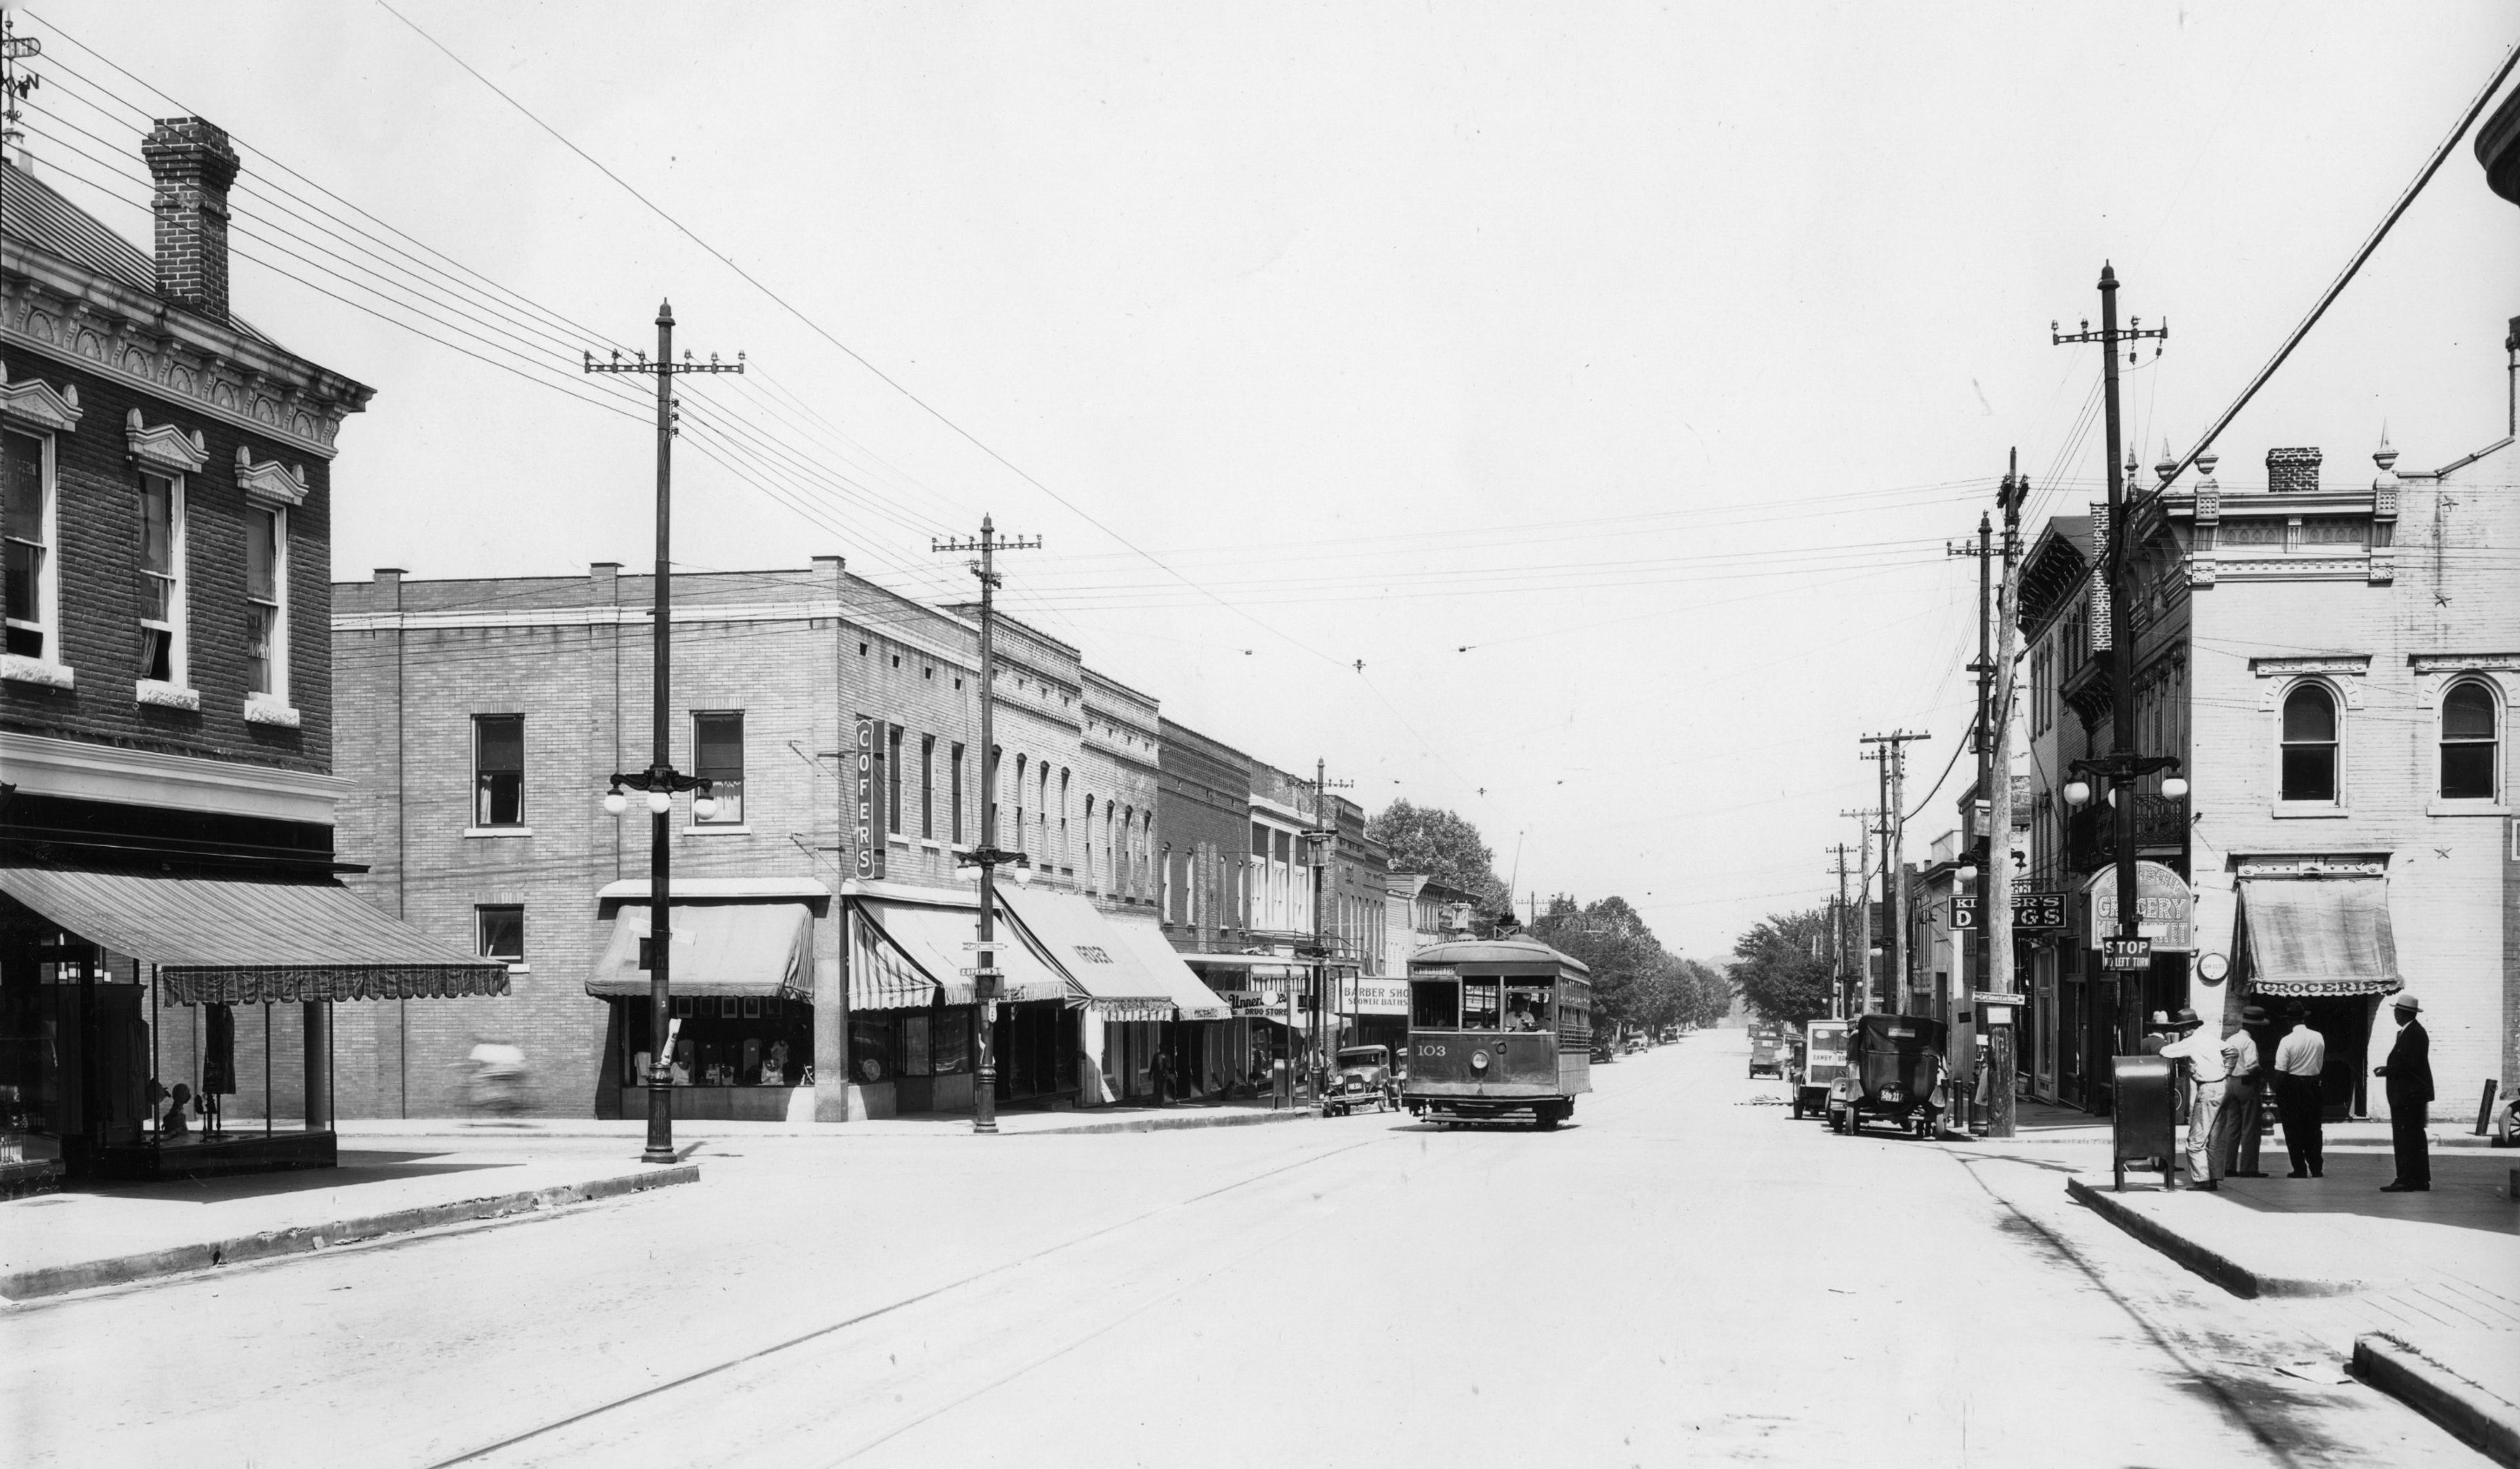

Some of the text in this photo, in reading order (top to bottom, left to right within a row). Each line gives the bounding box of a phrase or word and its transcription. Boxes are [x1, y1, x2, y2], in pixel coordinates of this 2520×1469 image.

[859, 730, 870, 868] COFERS
[1956, 897, 2059, 908] KIER'S
[2097, 895, 2187, 919] GRCERY
[1956, 909, 2060, 927] DGS
[2105, 941, 2148, 954] STOP
[2105, 957, 2149, 967] NO LEFT TURN
[1344, 987, 1409, 998] BARBER SHO
[2261, 982, 2394, 993] GROCERIE
[1418, 1045, 1446, 1057] 103
